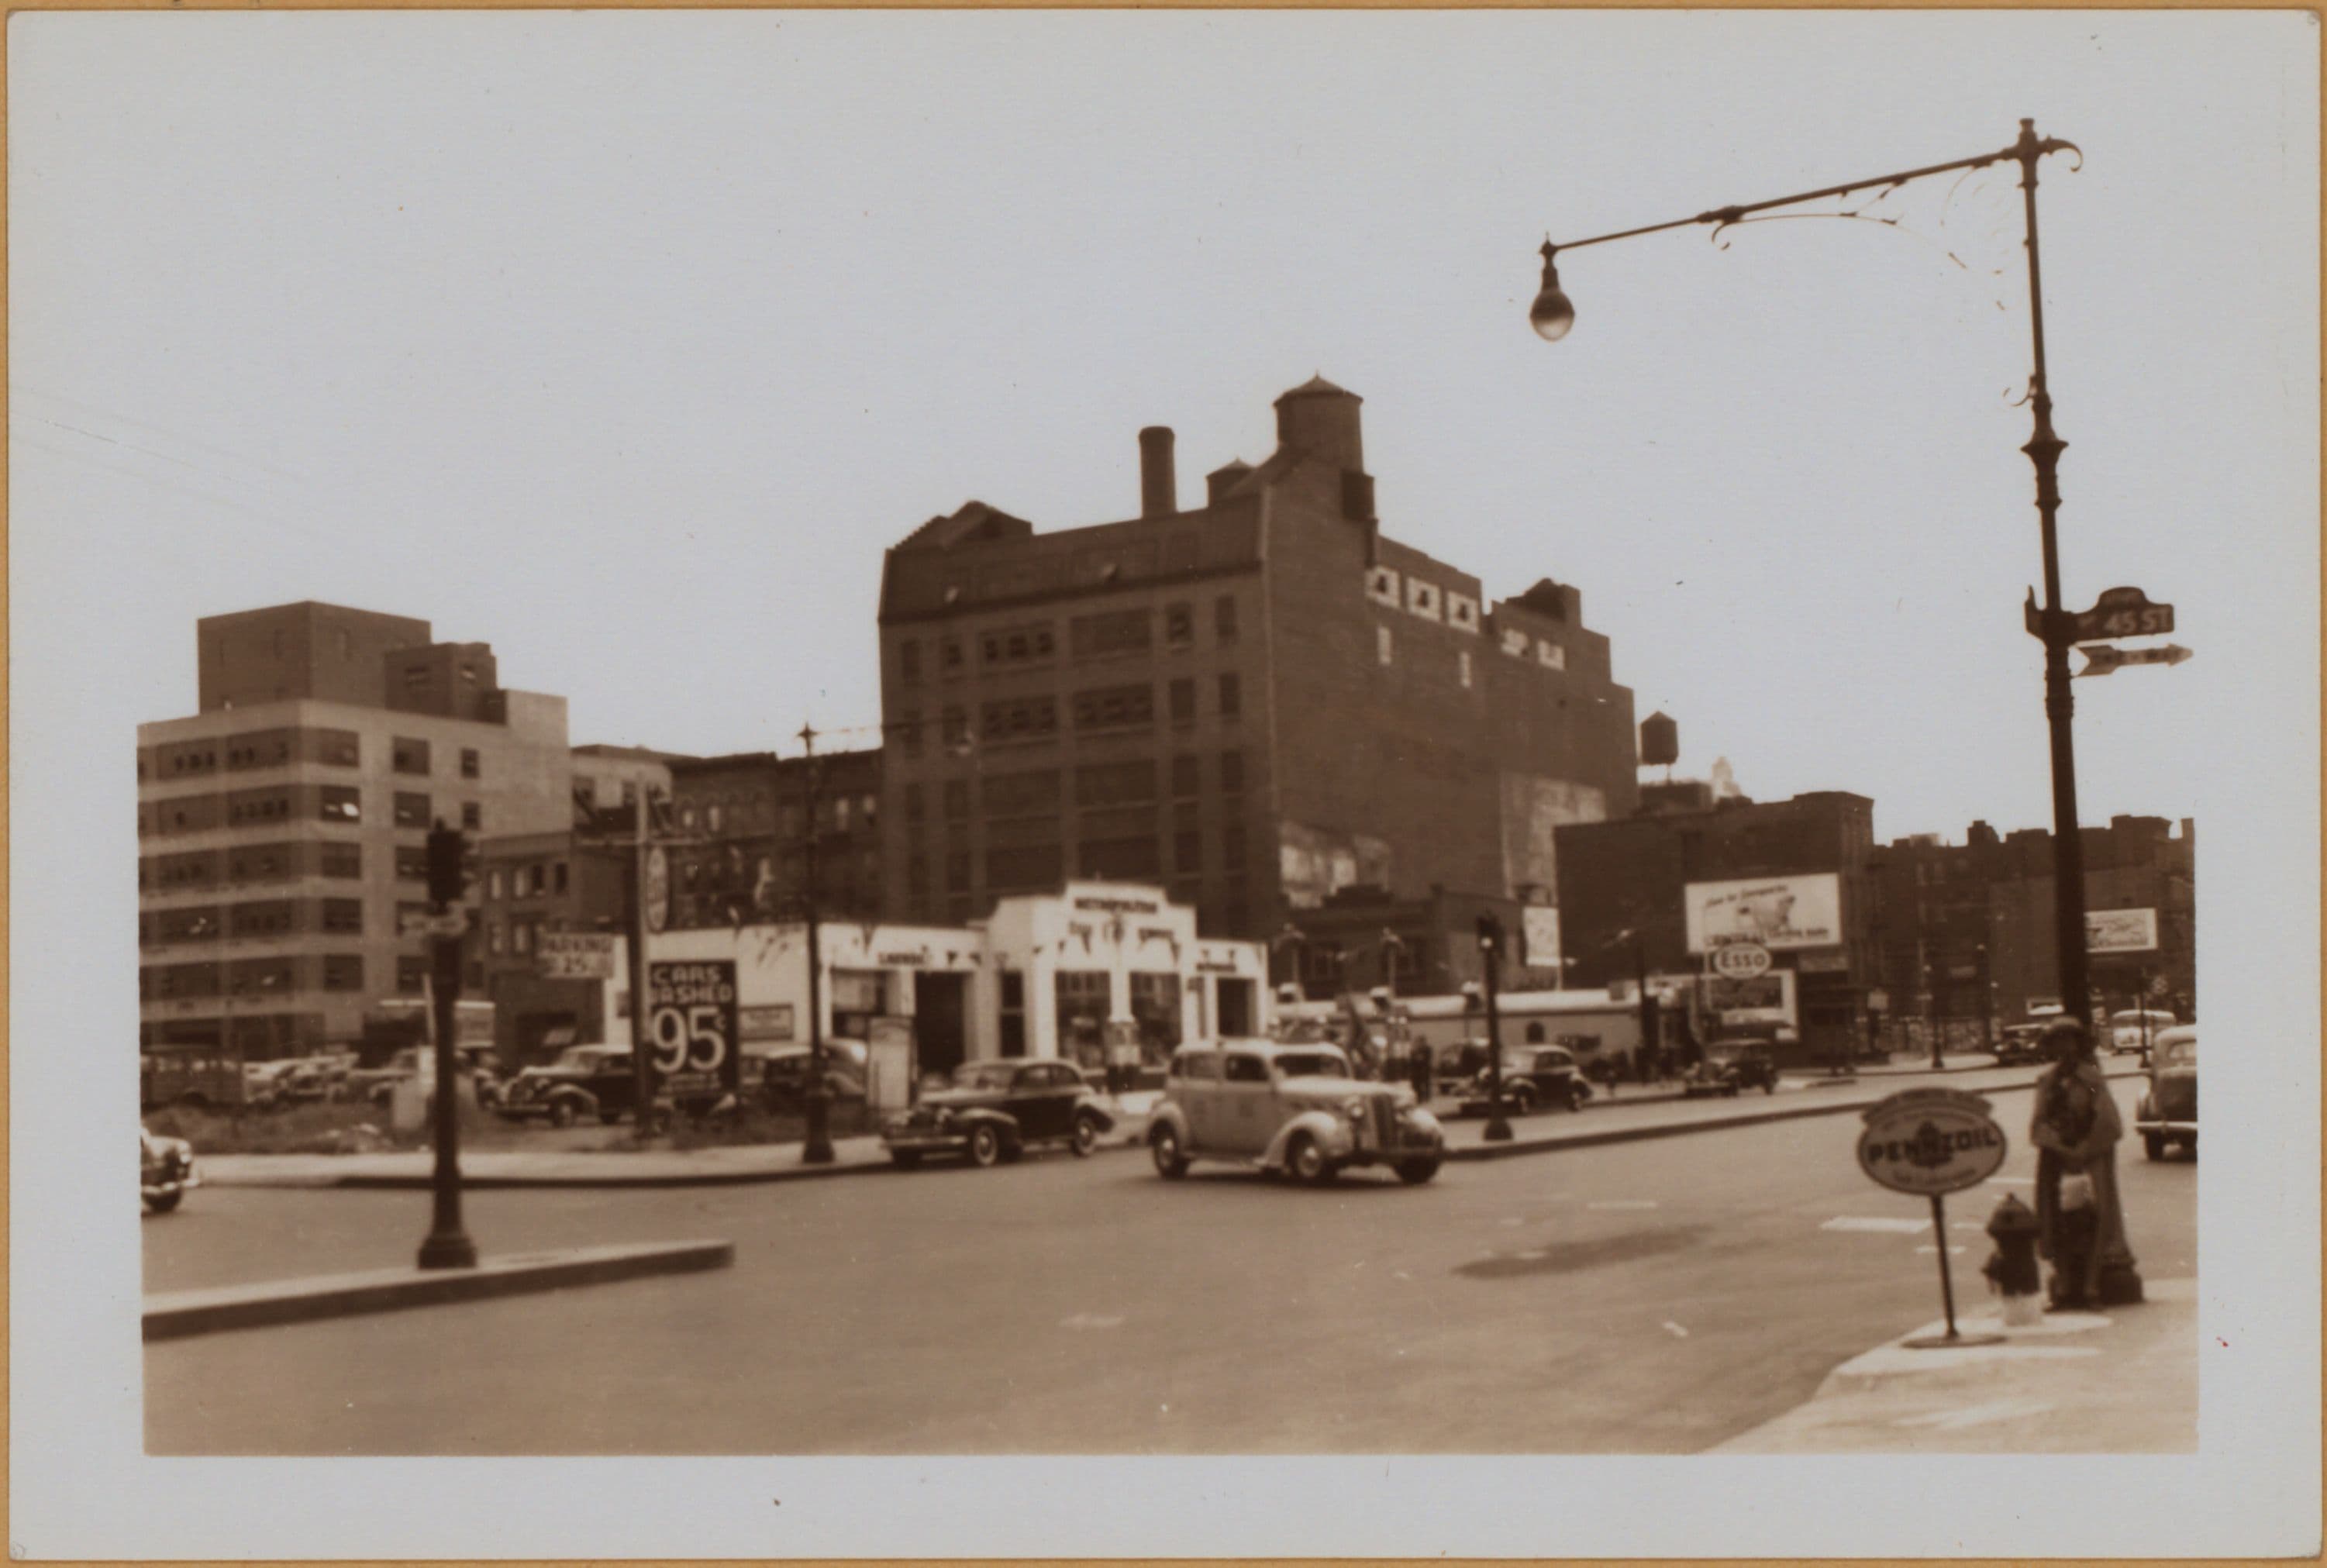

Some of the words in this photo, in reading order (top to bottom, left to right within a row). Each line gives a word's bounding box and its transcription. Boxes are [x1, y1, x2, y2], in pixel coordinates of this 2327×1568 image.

[2104, 611, 2137, 634] 45
[653, 967, 721, 984] CARS
[1867, 1126, 1998, 1165] PENZOIL
